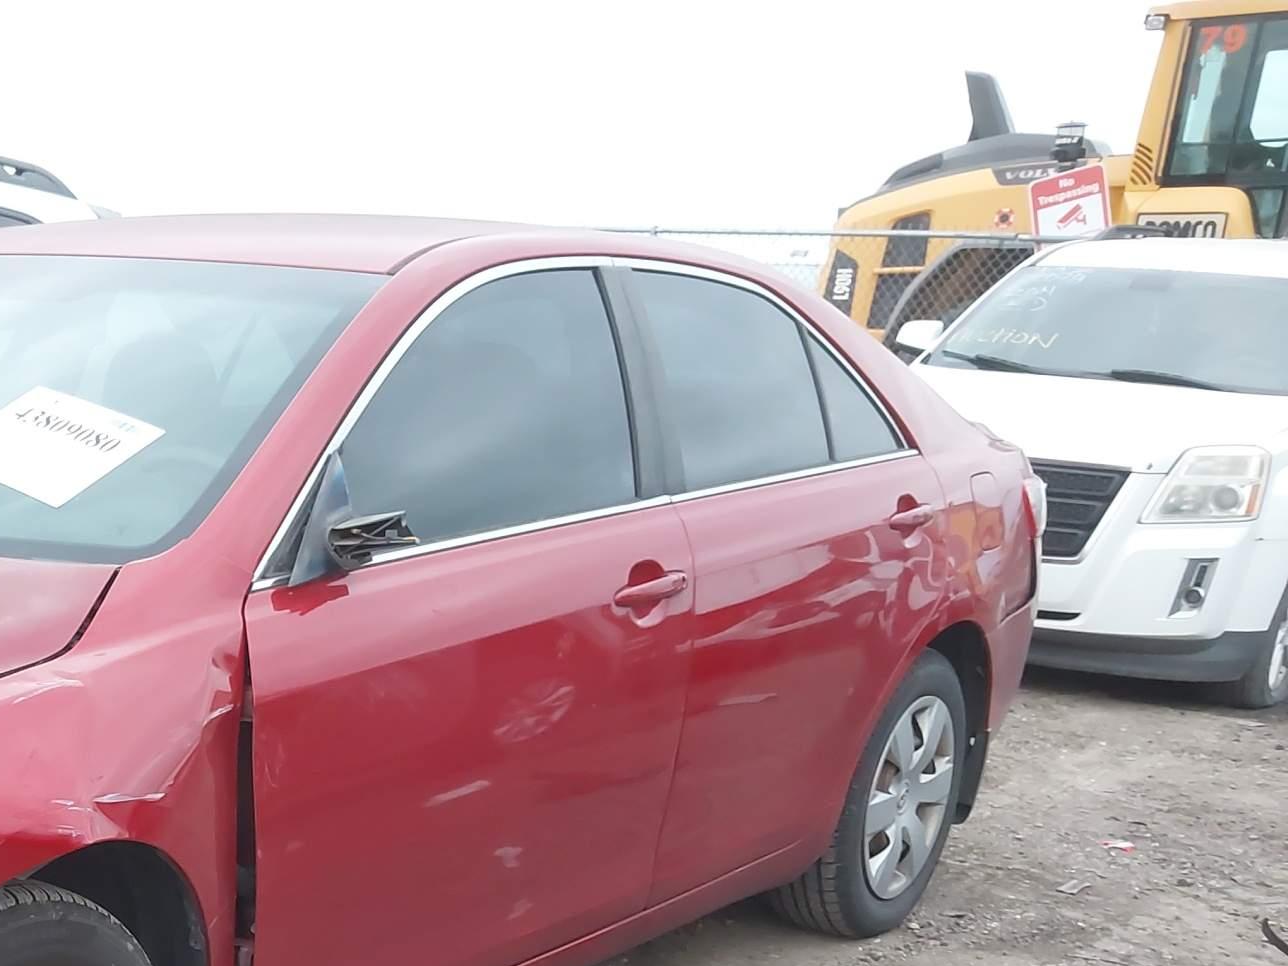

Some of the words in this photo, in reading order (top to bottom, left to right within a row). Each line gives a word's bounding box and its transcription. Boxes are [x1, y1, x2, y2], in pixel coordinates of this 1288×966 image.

[1199, 24, 1248, 54] 79
[1005, 167, 1058, 180] VOLV
[1058, 177, 1076, 189] No
[1037, 182, 1100, 206] Trespassing
[15, 407, 121, 453] 43809080
